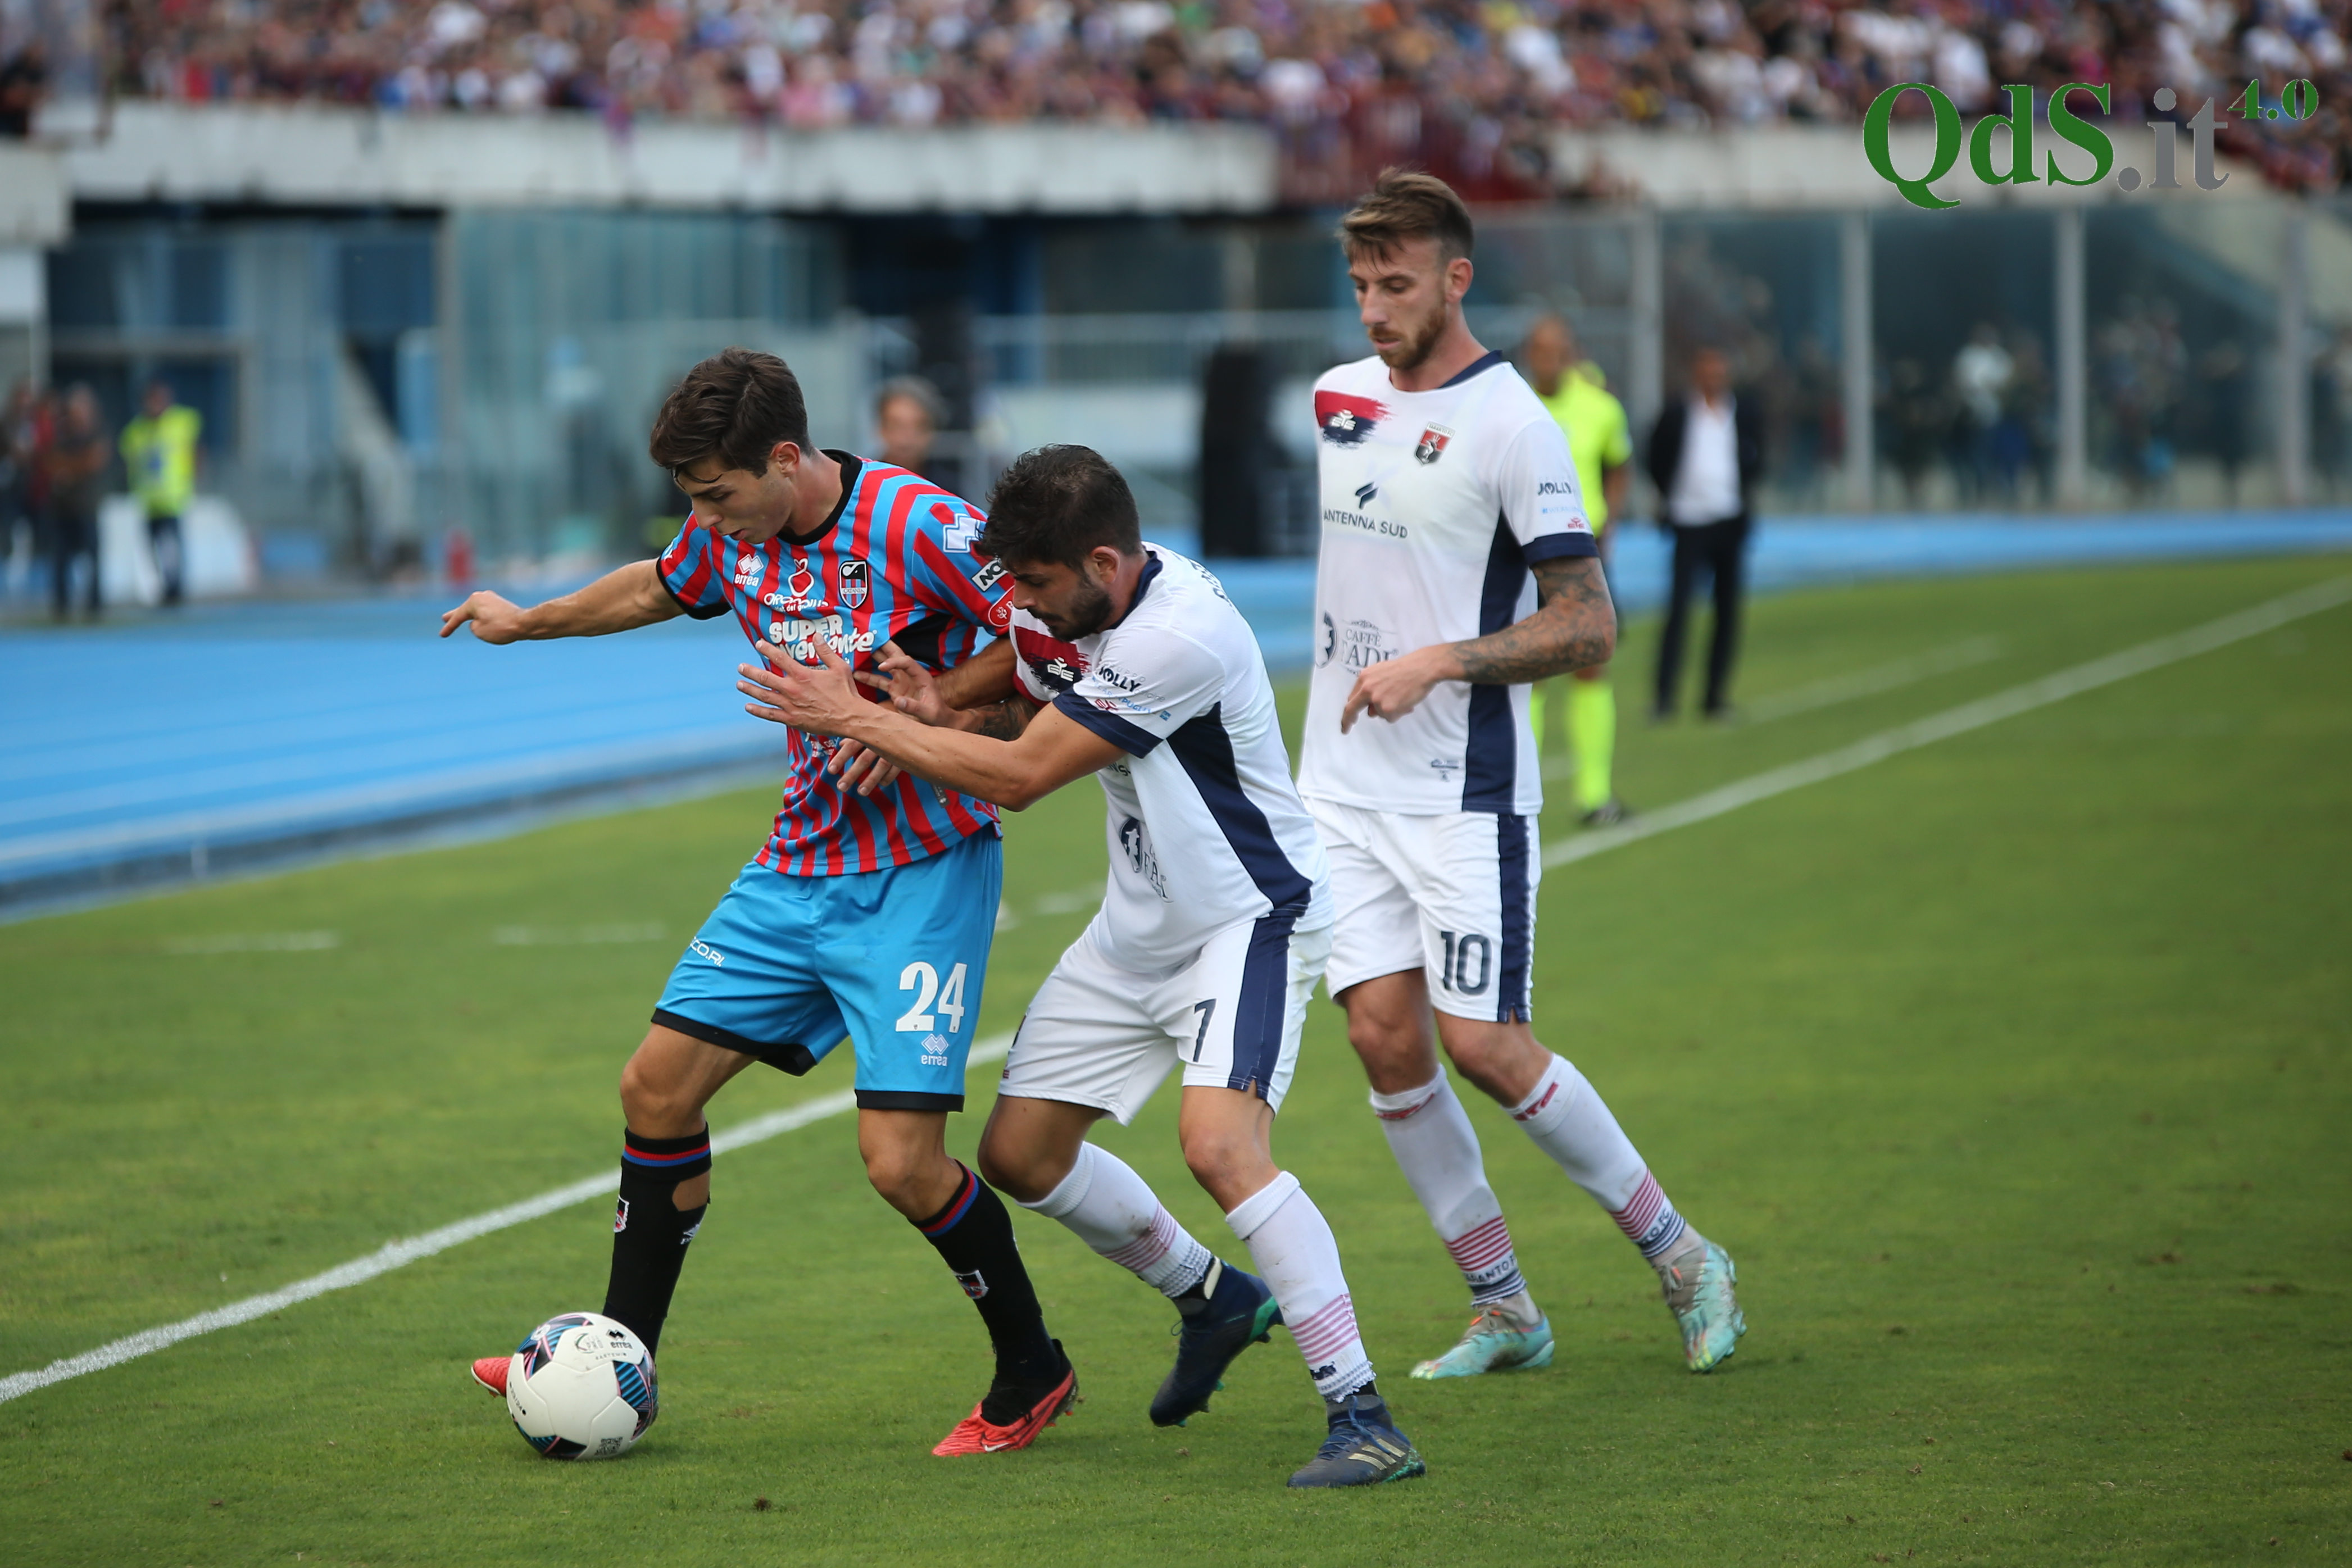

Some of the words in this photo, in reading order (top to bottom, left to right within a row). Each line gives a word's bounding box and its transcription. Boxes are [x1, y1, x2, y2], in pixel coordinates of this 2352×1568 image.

[1324, 508, 1376, 531] ANTENNA
[1380, 521, 1409, 538] SUD
[734, 573, 760, 587] errea
[769, 615, 843, 644] SUPER
[1098, 666, 1142, 693] JOLLY
[1441, 930, 1492, 996] 10
[895, 961, 968, 1033] 24
[1193, 998, 1216, 1062] 7
[921, 1055, 947, 1066] errea
